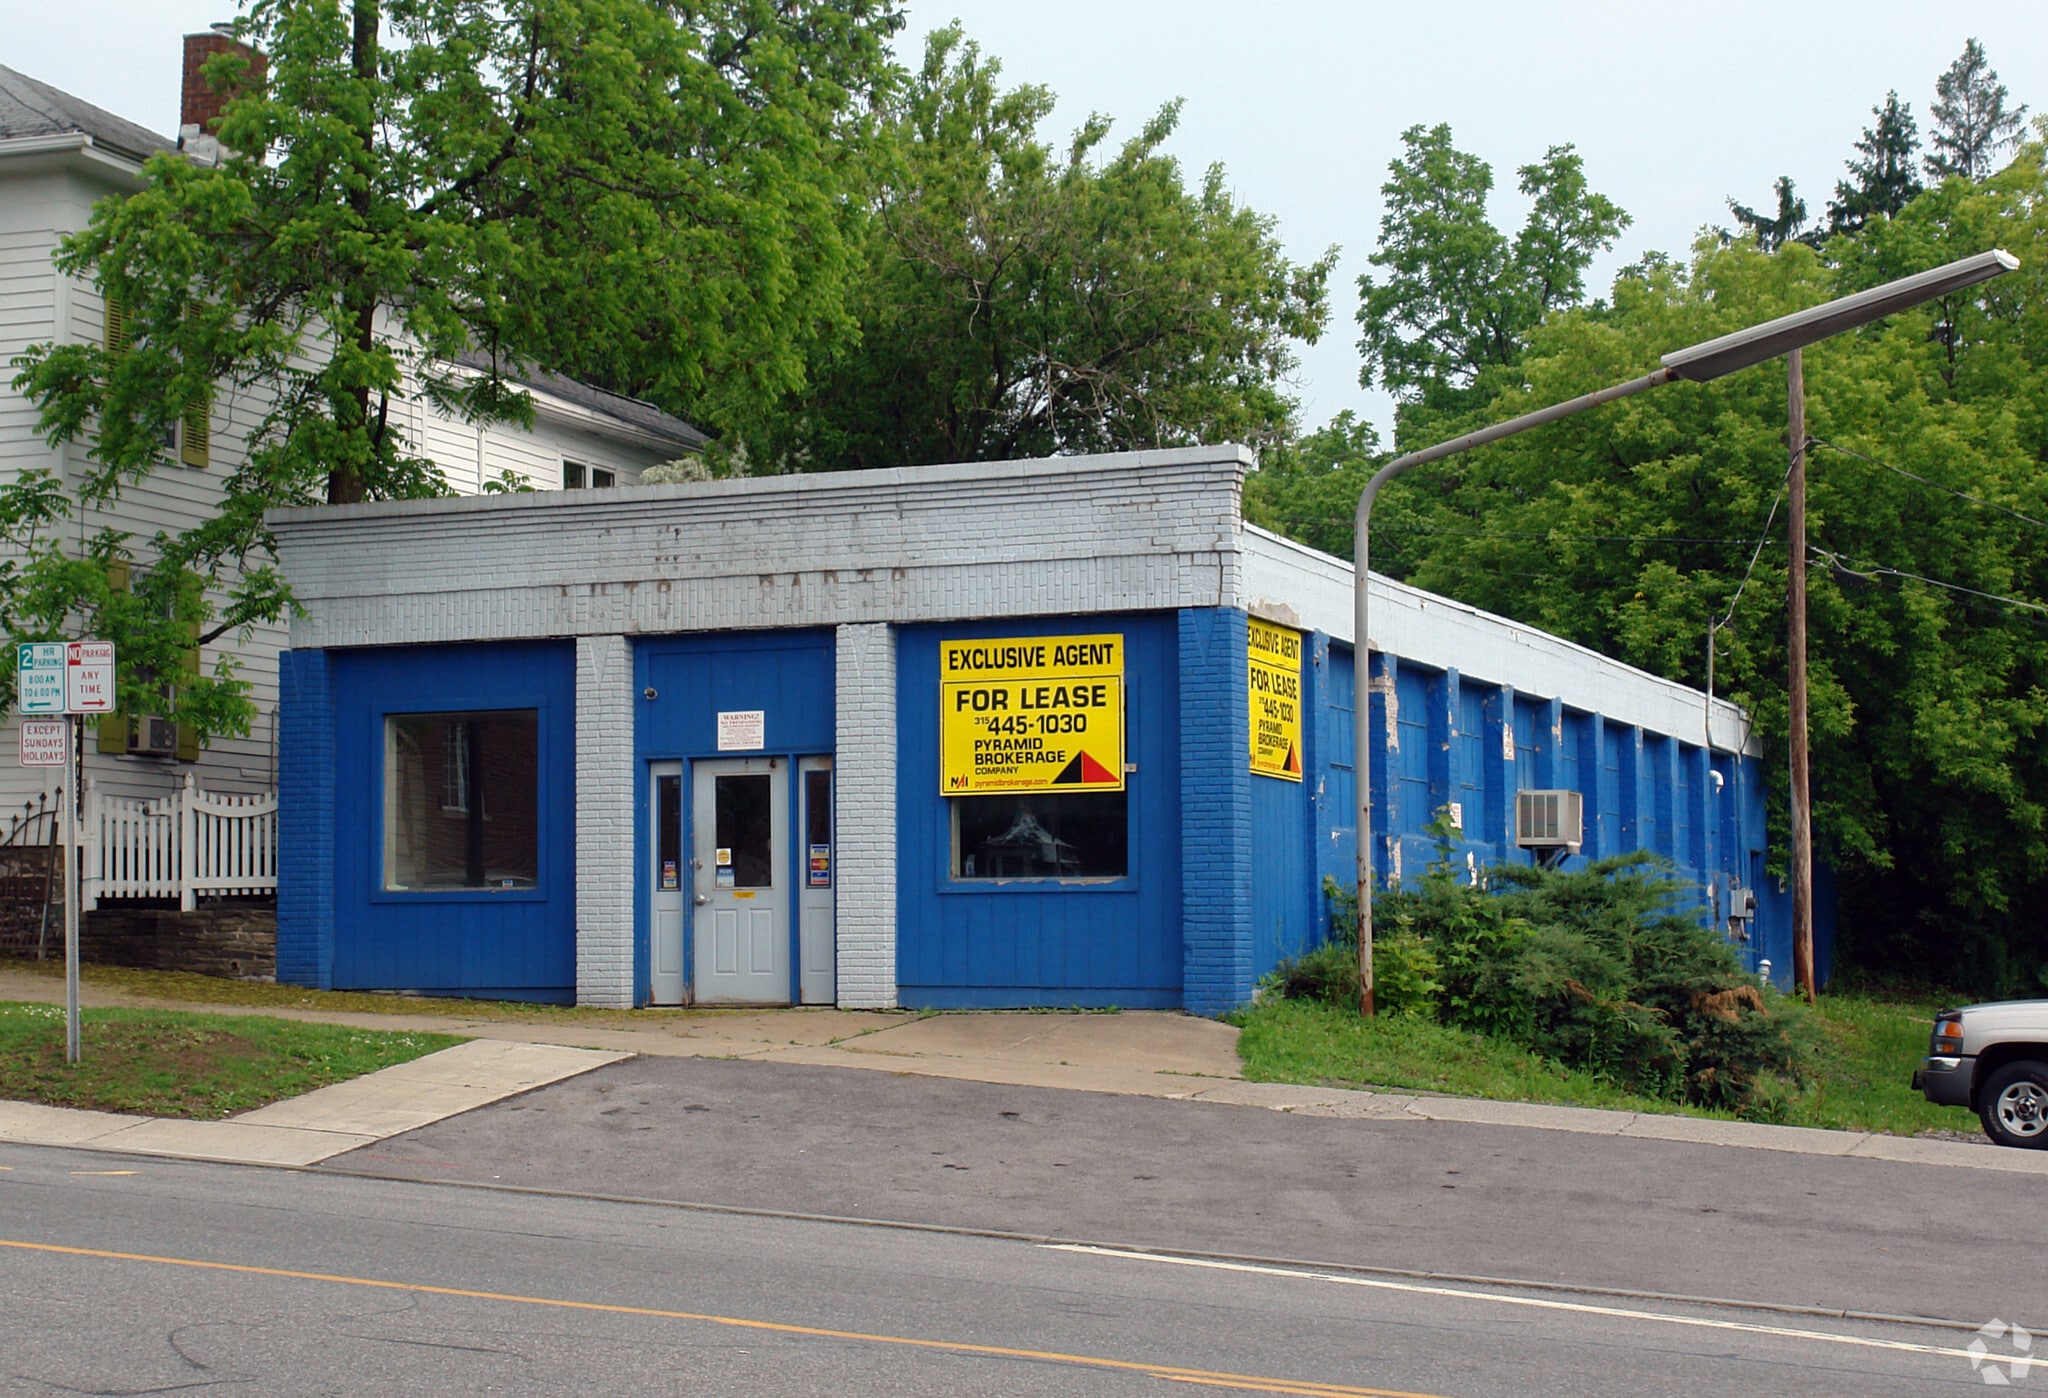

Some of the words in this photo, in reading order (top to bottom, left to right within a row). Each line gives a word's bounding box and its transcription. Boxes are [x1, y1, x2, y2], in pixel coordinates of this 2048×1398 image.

[1248, 626, 1279, 654] EXCLUSIVE
[1281, 635, 1299, 660] AGENT
[22, 649, 32, 666] 2
[43, 648, 55, 656] HR
[69, 648, 81, 661] NO
[82, 649, 111, 658] PARKING
[949, 646, 1046, 670] EXCLUSIVE
[1053, 643, 1114, 666] AGENT
[34, 659, 63, 667] PARKING
[81, 671, 99, 680] ANY
[80, 685, 102, 694] TIME
[1251, 667, 1270, 693] FOR
[1271, 672, 1297, 700] LEASE
[956, 689, 1008, 712] FOR
[1021, 685, 1106, 710] LEASE
[27, 725, 61, 735] EXCEPT
[974, 717, 990, 725] 315
[988, 714, 1087, 736] 445-1030
[1258, 719, 1282, 736] PYRAMID
[24, 738, 63, 748] SUNDAYS
[974, 738, 1043, 752] PYRAMID
[1258, 732, 1288, 750] BROKERAGE
[23, 751, 65, 761] HOLIDAYS
[974, 751, 1066, 765] BROKERAGE
[974, 767, 1020, 775] COMPANY
[951, 774, 968, 789] NAI
